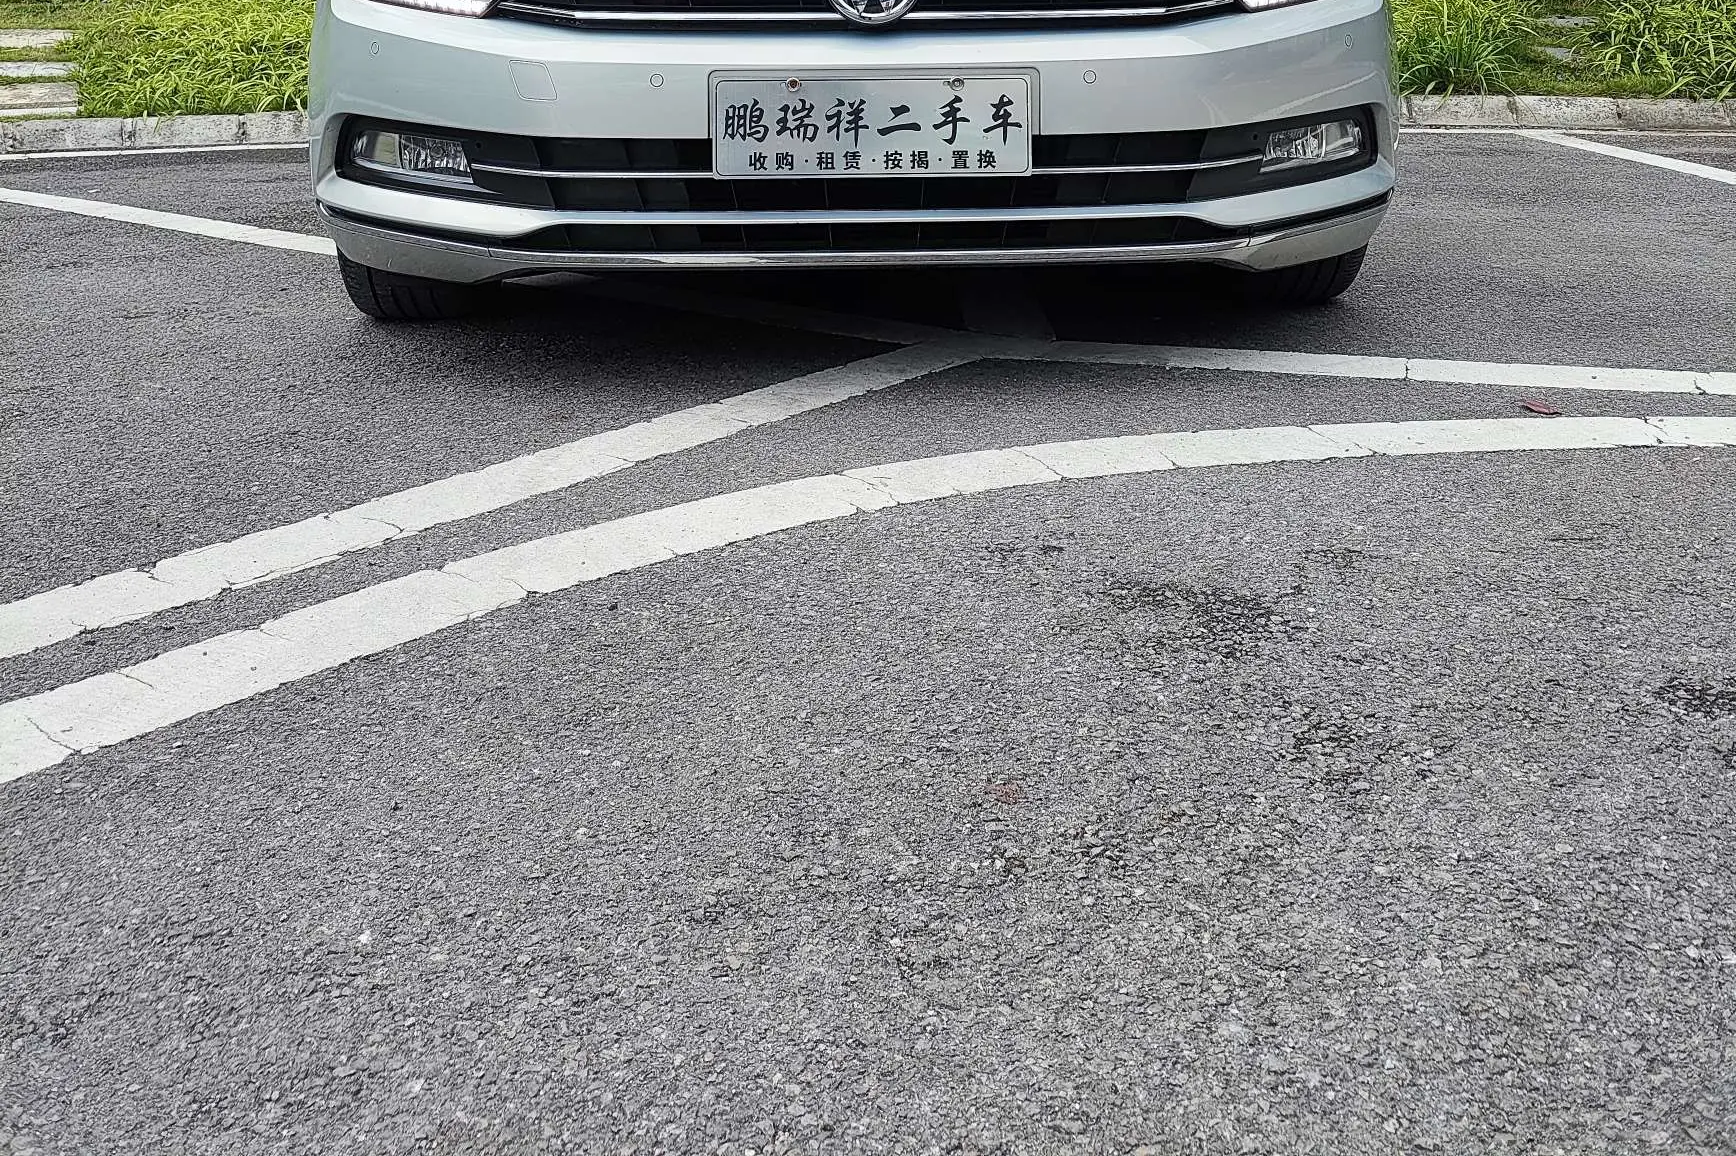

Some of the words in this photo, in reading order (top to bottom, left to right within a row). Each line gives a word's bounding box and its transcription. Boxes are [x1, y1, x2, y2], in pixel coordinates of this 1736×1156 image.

[722, 94, 1023, 148] 鹏瑞祥二手车
